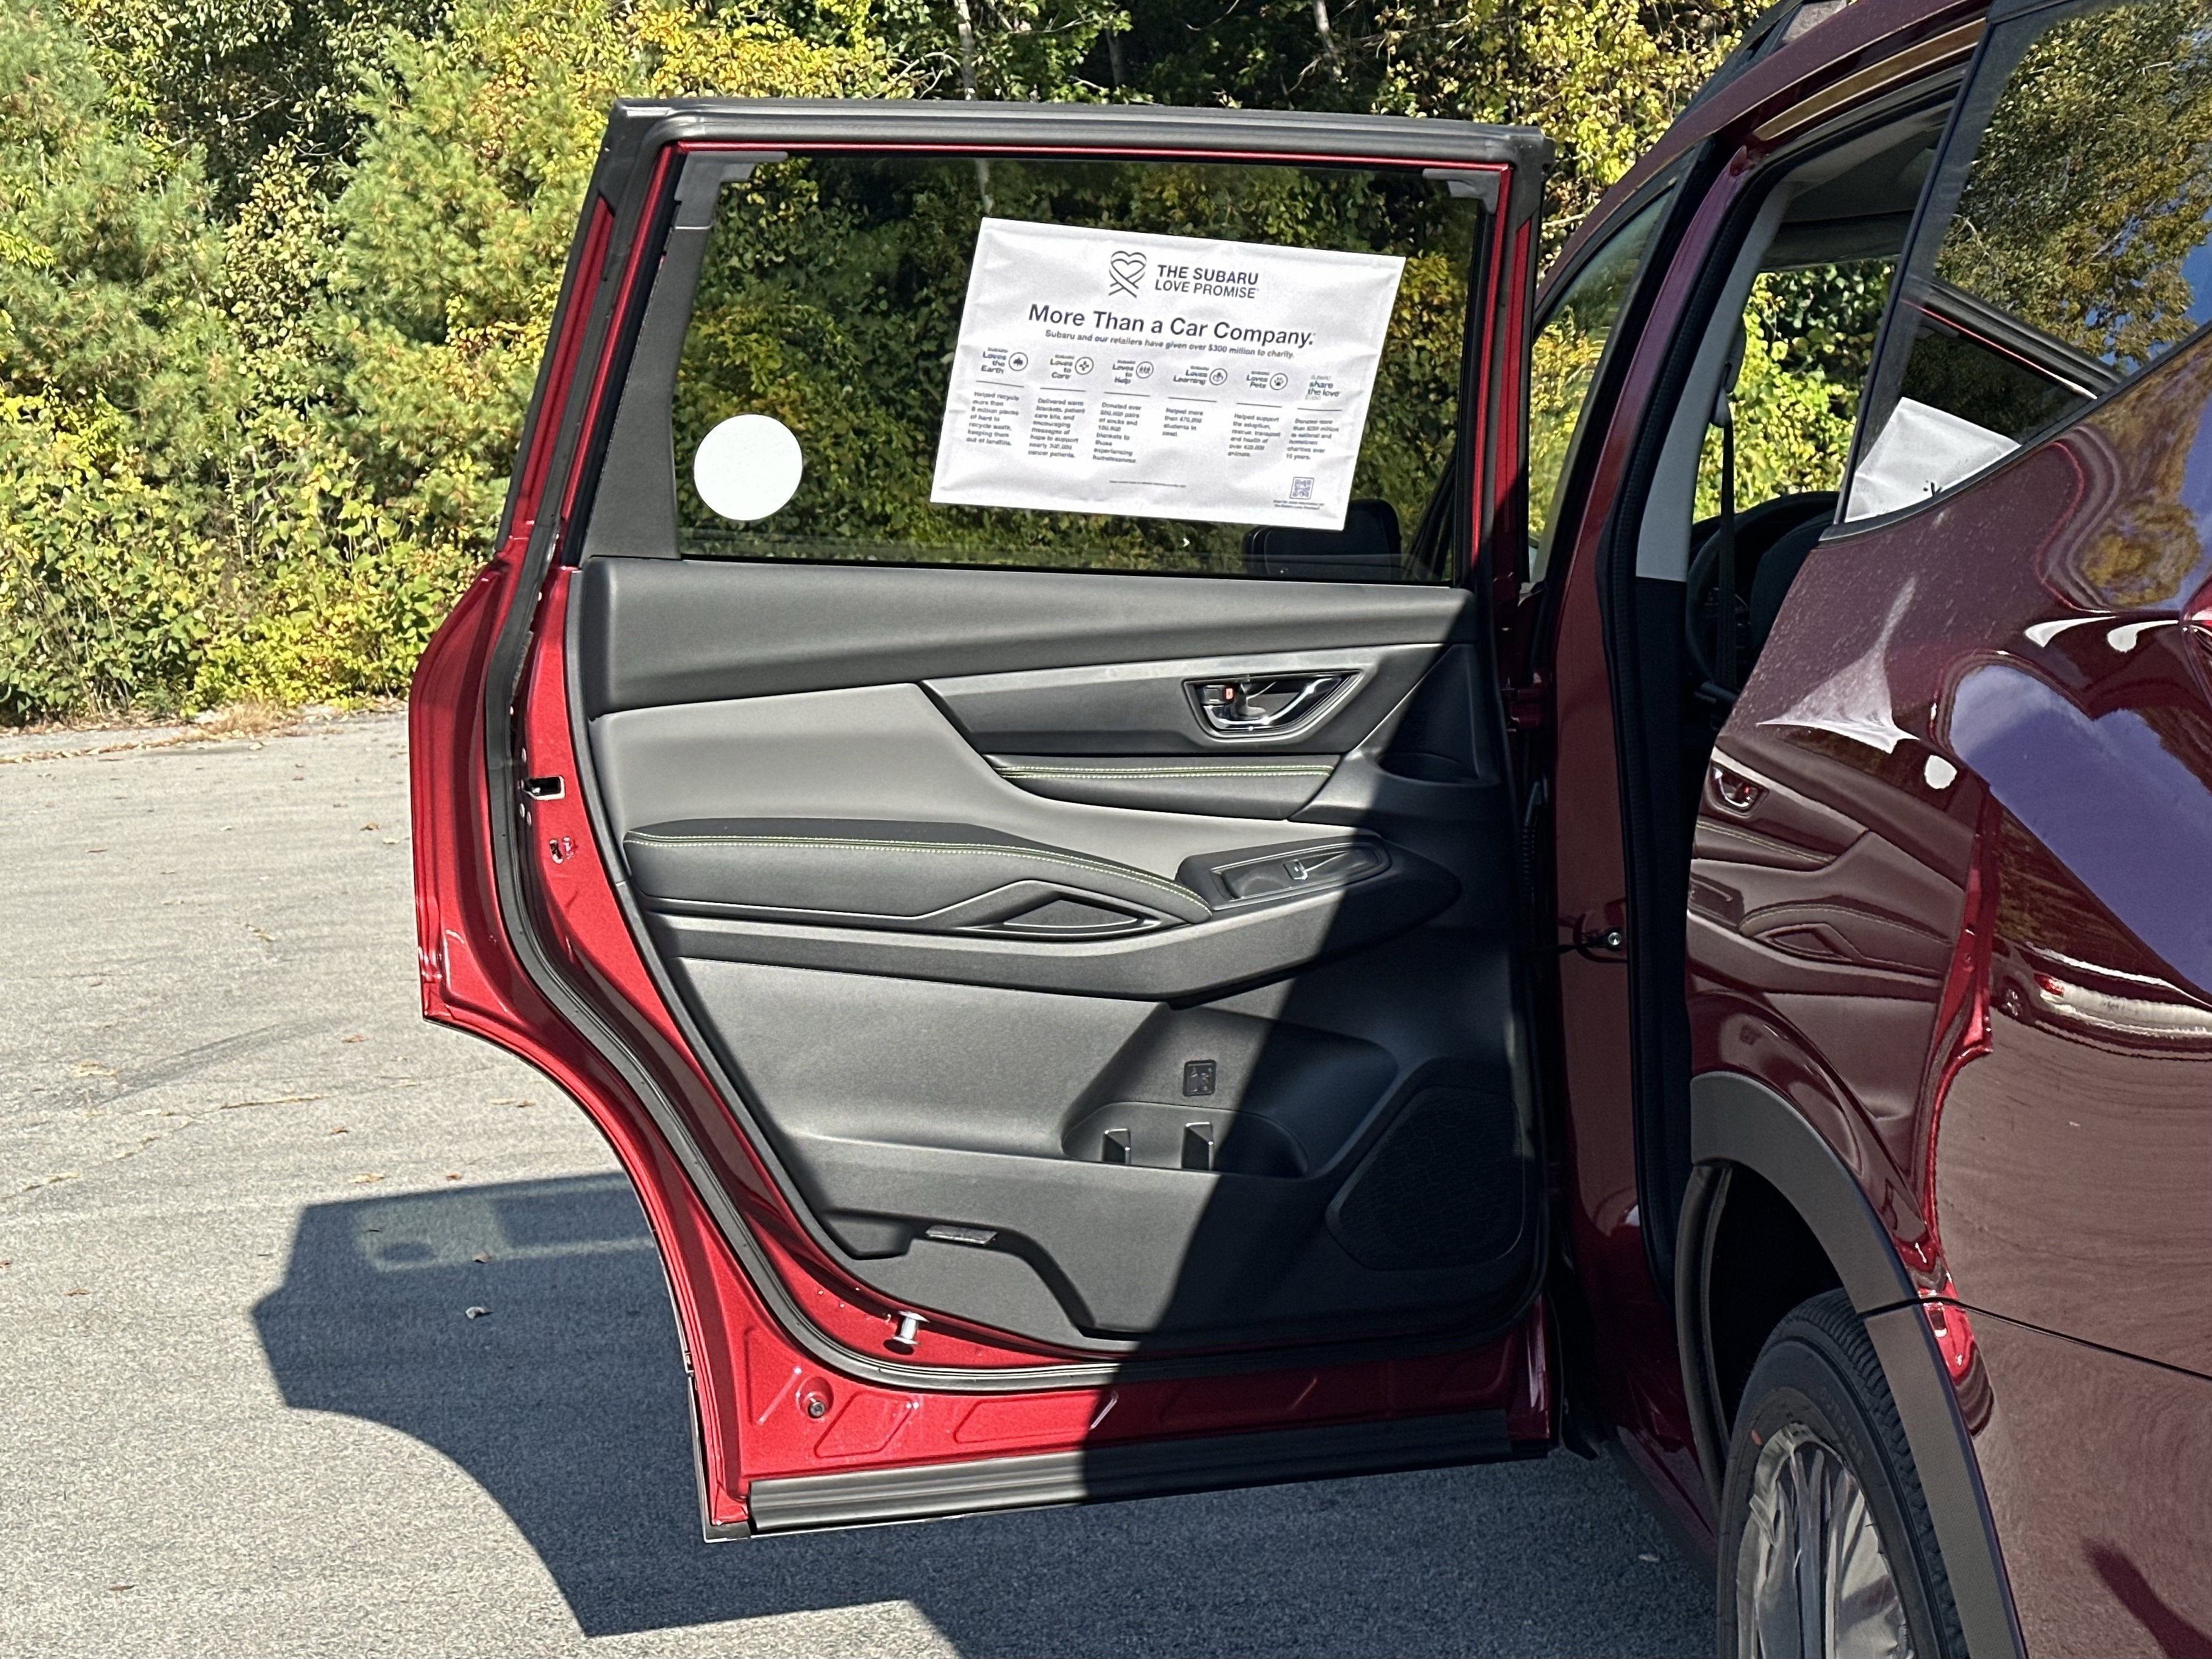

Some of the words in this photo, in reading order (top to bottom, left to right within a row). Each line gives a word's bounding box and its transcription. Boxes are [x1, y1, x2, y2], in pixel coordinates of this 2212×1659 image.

[1158, 265, 1189, 279] THE
[1193, 268, 1258, 285] SUBARU
[1155, 279, 1190, 293] LOVE
[1194, 283, 1256, 299] PROMISE
[1029, 304, 1085, 326] More
[1093, 311, 1144, 332] Than
[1151, 320, 1163, 334] a
[1171, 318, 1208, 337] Car
[1214, 322, 1313, 348] Company.
[1046, 330, 1075, 340] Subaru
[1110, 337, 1142, 346] retailers
[1166, 341, 1186, 349] given
[1208, 344, 1227, 353] $300
[983, 351, 1007, 360] Loves
[981, 365, 1004, 374] Earth
[1310, 380, 1333, 389] share
